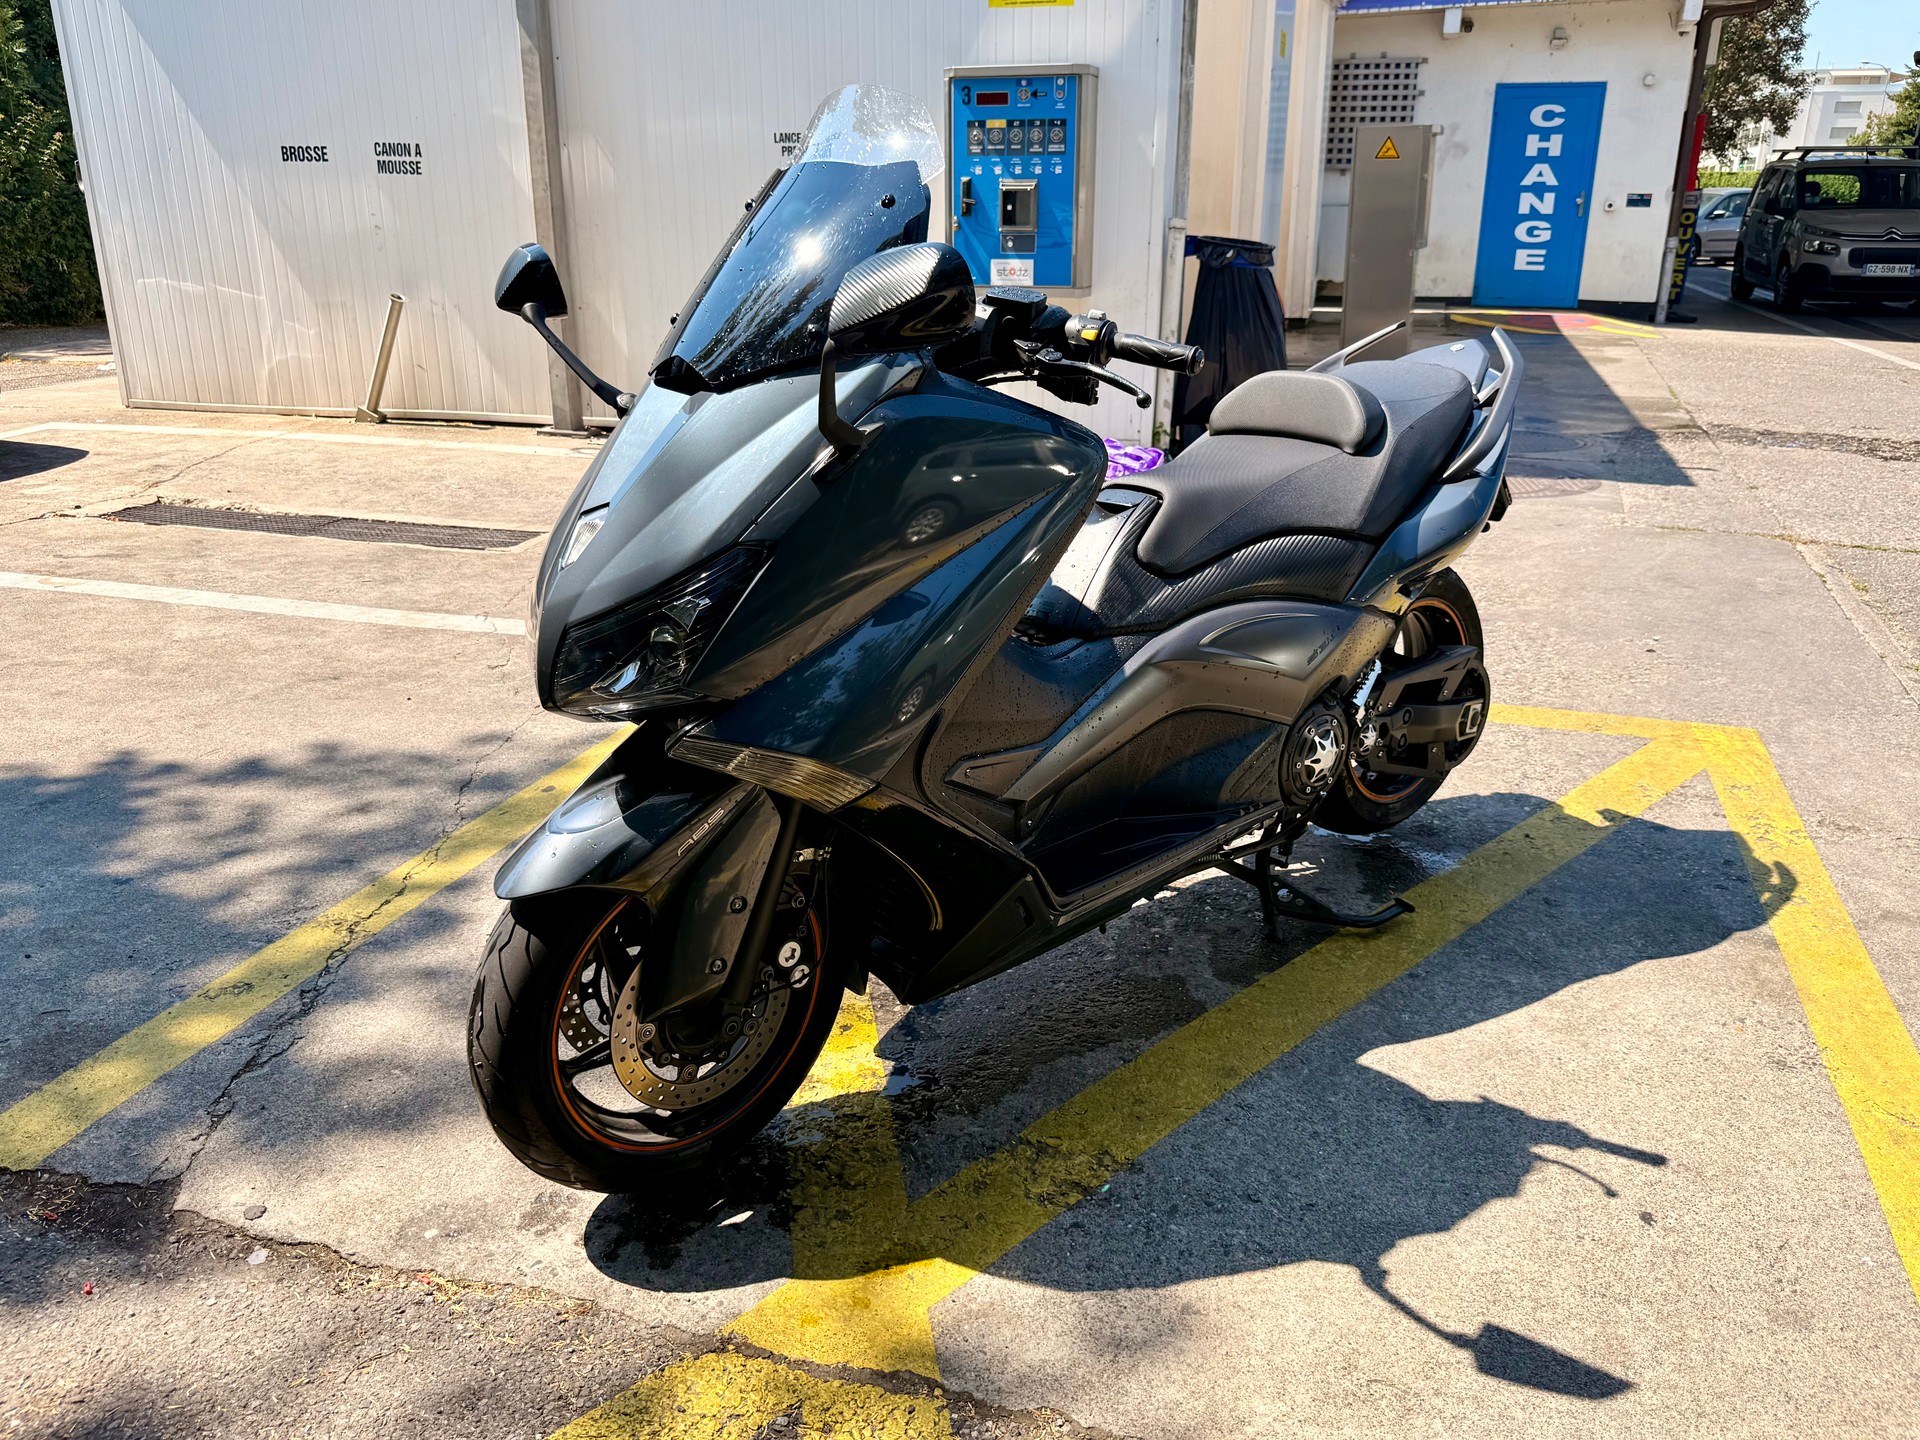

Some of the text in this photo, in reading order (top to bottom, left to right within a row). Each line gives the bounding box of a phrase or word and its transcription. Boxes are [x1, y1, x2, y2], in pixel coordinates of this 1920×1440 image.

[961, 86, 971, 105] 3
[281, 145, 329, 162] BROSSE
[374, 142, 422, 158] CANON A
[376, 159, 423, 175] MOUSSE
[1513, 104, 1567, 271] CHANGE
[1669, 212, 1696, 300] OUVERT
